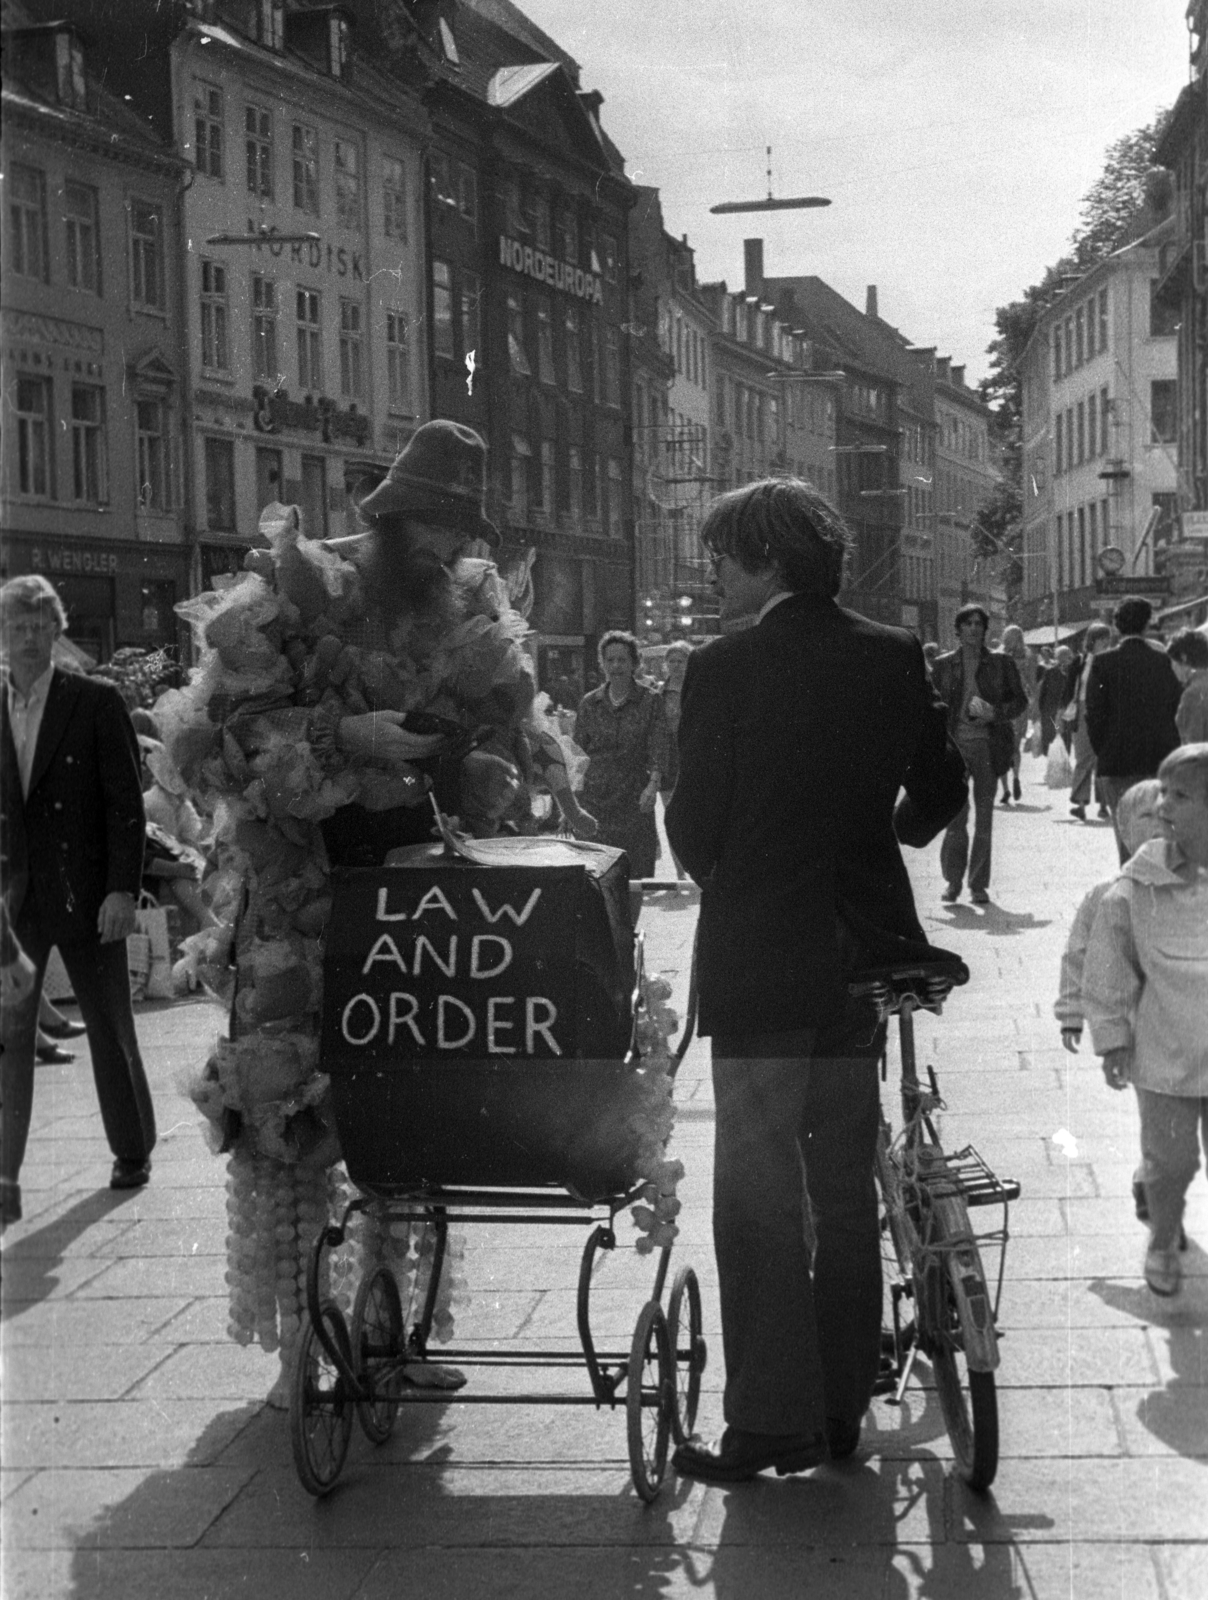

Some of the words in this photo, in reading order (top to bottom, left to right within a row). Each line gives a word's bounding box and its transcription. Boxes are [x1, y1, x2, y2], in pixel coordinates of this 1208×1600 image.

[500, 235, 604, 306] NORDEUROPA
[377, 886, 541, 925] LAW
[363, 935, 513, 979] AND
[342, 993, 563, 1055] ORDER
